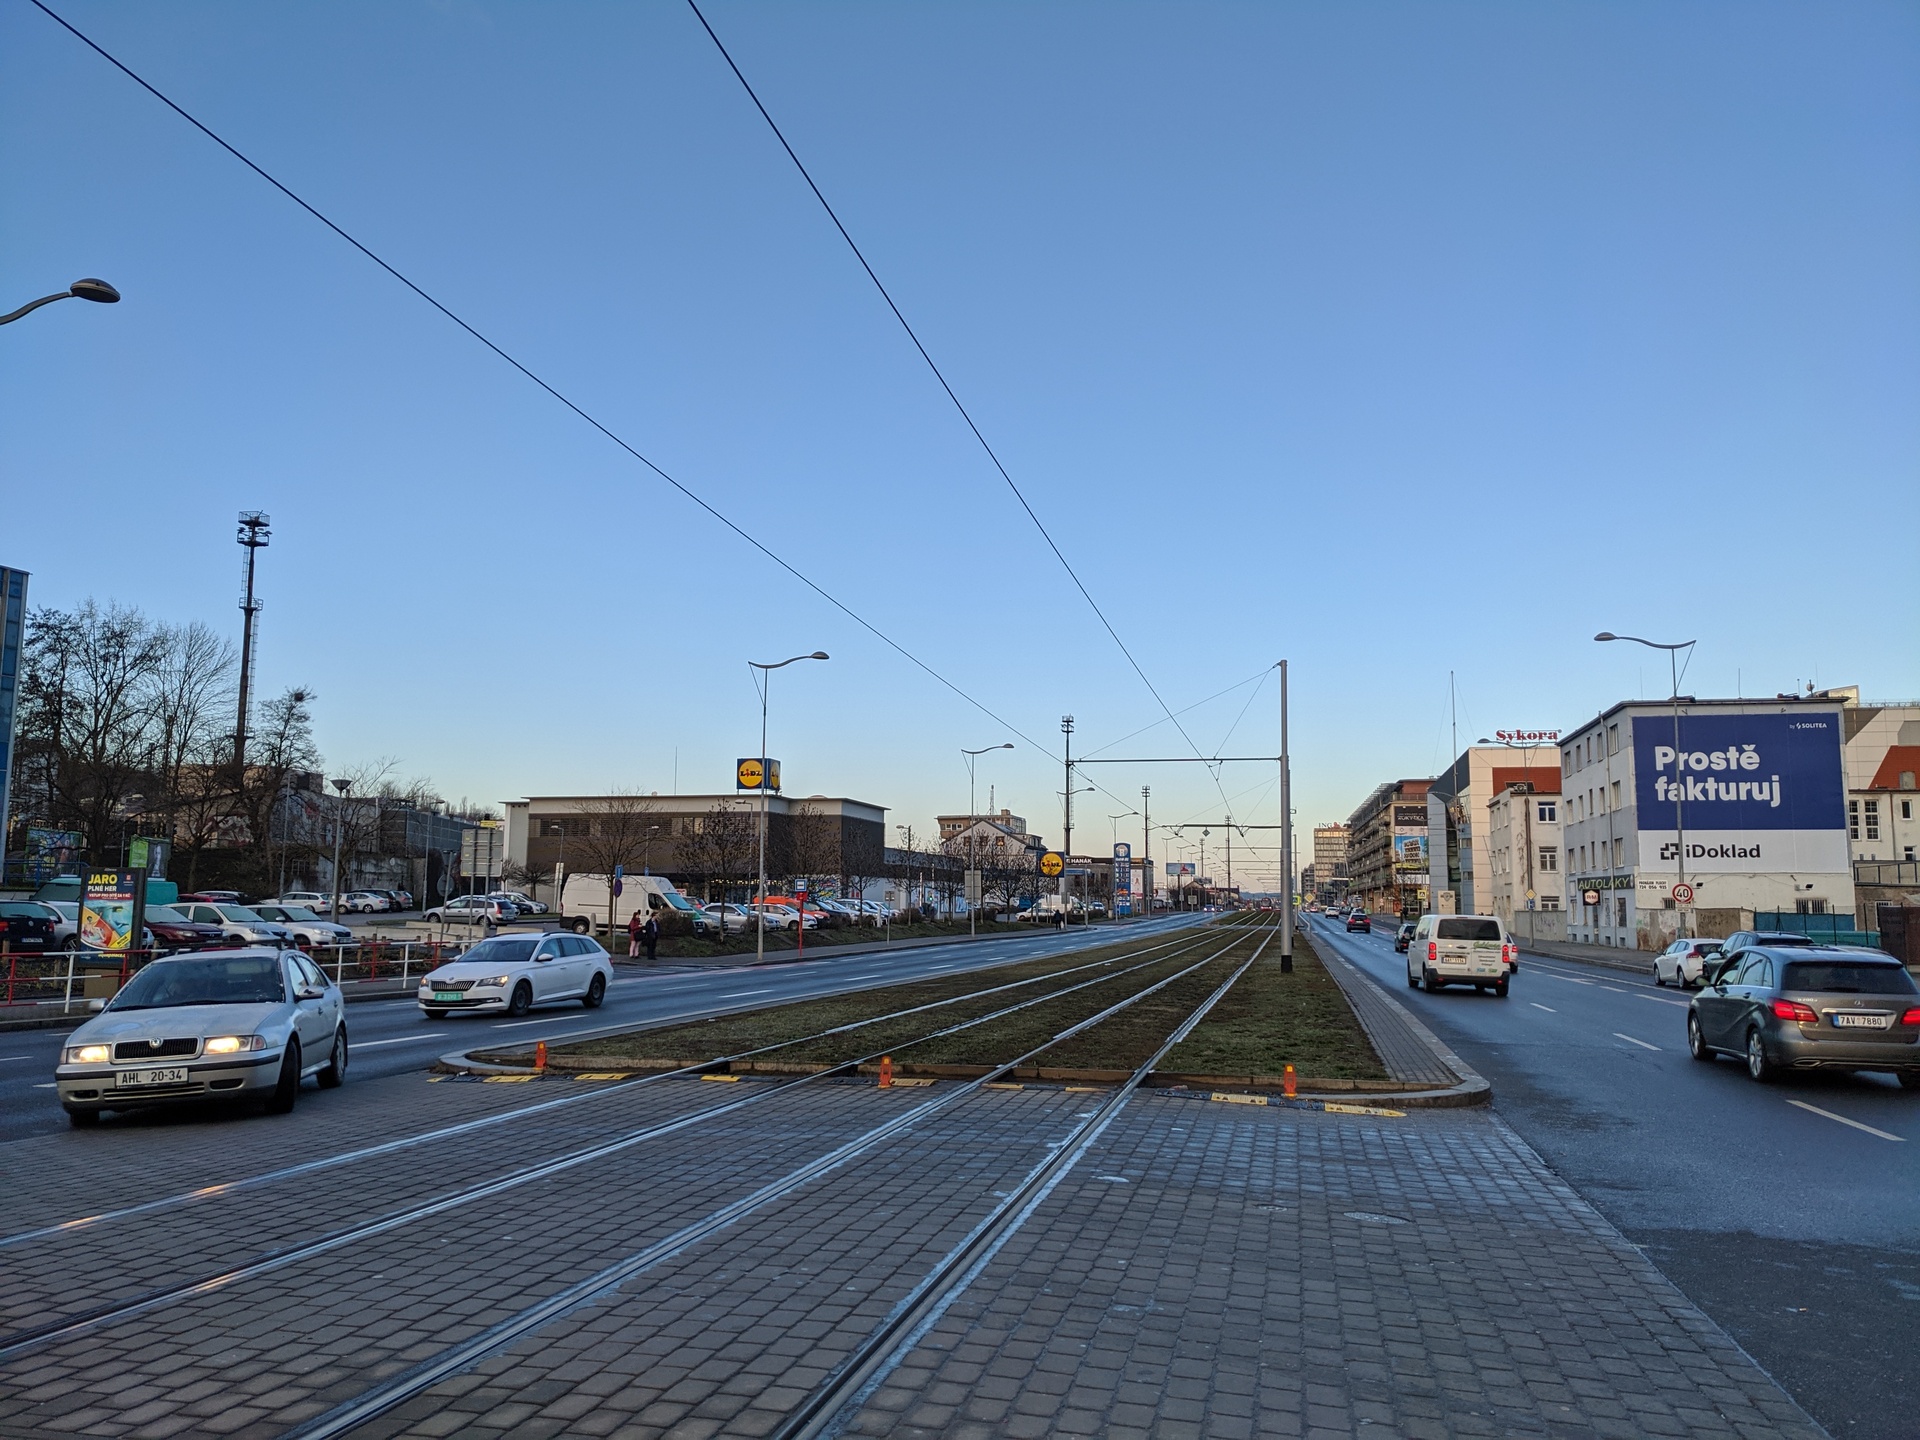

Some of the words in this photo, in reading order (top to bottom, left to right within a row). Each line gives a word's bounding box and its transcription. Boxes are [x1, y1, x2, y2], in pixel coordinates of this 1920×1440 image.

[1496, 729, 1558, 744] Sykora
[1655, 744, 1760, 771] Prostě
[1655, 775, 1781, 807] fakturuj
[1685, 844, 1761, 859] iDoklad
[88, 874, 118, 885] JARO
[1578, 877, 1630, 890] AUTOLAKY
[87, 884, 104, 892] PLNÉ
[1676, 888, 1690, 898] 40
[1840, 1016, 1856, 1025] 7AV
[122, 1072, 141, 1084] AHL
[151, 1069, 182, 1082] 20-34
